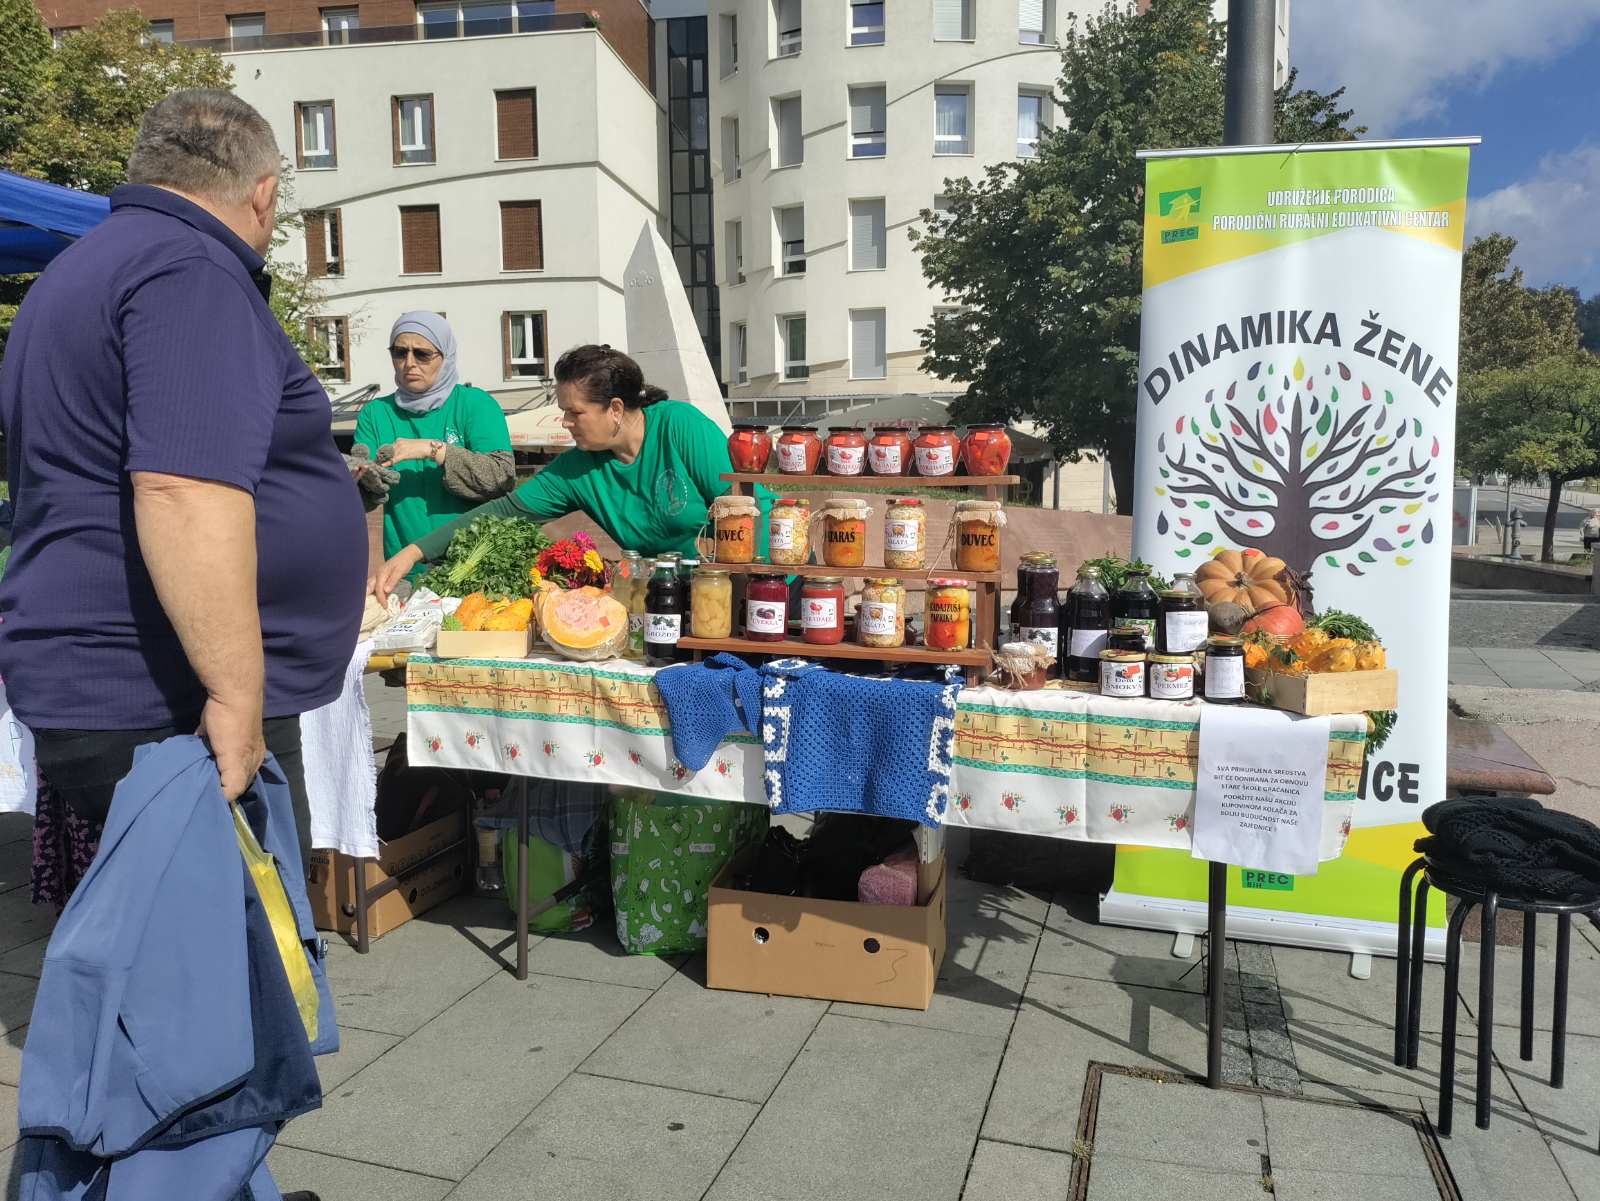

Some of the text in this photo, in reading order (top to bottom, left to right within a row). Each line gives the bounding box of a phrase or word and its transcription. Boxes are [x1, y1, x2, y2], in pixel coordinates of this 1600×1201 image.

[1267, 187, 1396, 206] UDRUŽENJE PORODICA
[1213, 210, 1449, 231] PORODIČNI RURALNI EDUKATIVNI CENTAR
[1164, 228, 1196, 243] PREC
[1143, 309, 1454, 407] DINAMIKA ŽENE
[717, 525, 745, 542] UVEČ
[1231, 766, 1273, 775] PRIKUPLJENA
[1274, 769, 1307, 777] SREDSTVA
[1234, 775, 1269, 784] DONIRANA
[1279, 778, 1309, 787] OBNOVU
[1242, 783, 1261, 792] ŠKOLE
[1223, 793, 1297, 807] PODRŽITE NAŠU AKCIJU
[1221, 802, 1262, 811] KUPOVINOM
[1262, 805, 1288, 816] KOLAČA
[1239, 821, 1273, 832] ZAJEDNICE
[1280, 817, 1299, 826] NAŠE
[1246, 871, 1289, 885] PREC
